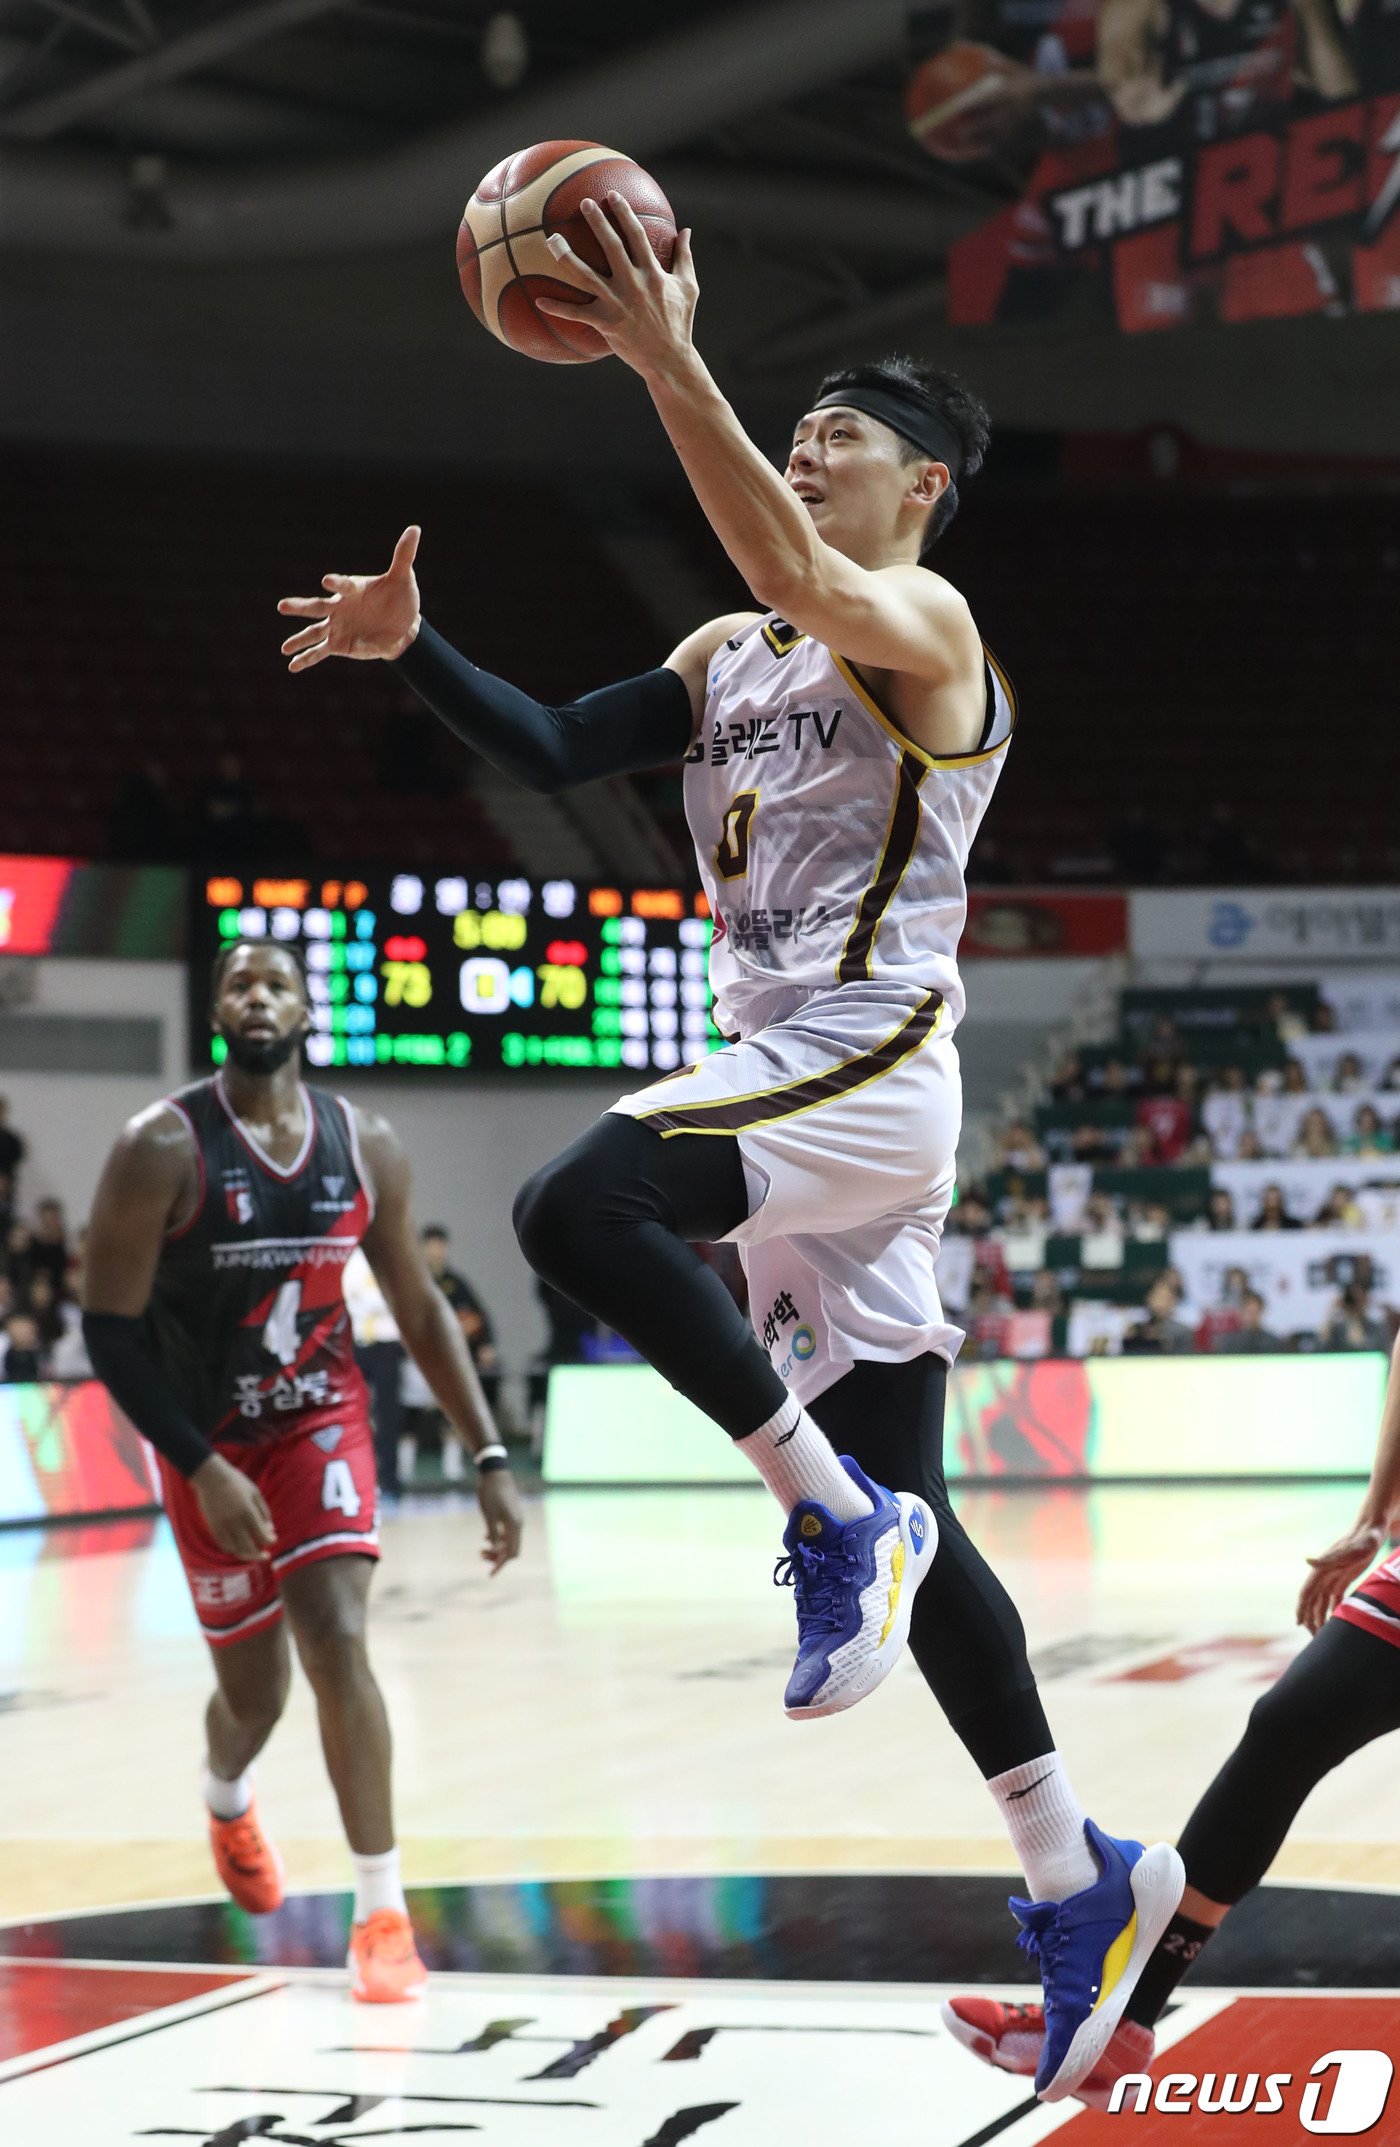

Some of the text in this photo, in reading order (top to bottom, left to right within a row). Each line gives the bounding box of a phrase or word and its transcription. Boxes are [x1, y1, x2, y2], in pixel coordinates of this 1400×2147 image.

[1051, 157, 1184, 249] THE
[787, 708, 843, 751] TV
[714, 787, 761, 883] 0
[261, 1278, 303, 1367] 4
[321, 1458, 361, 1518] 4
